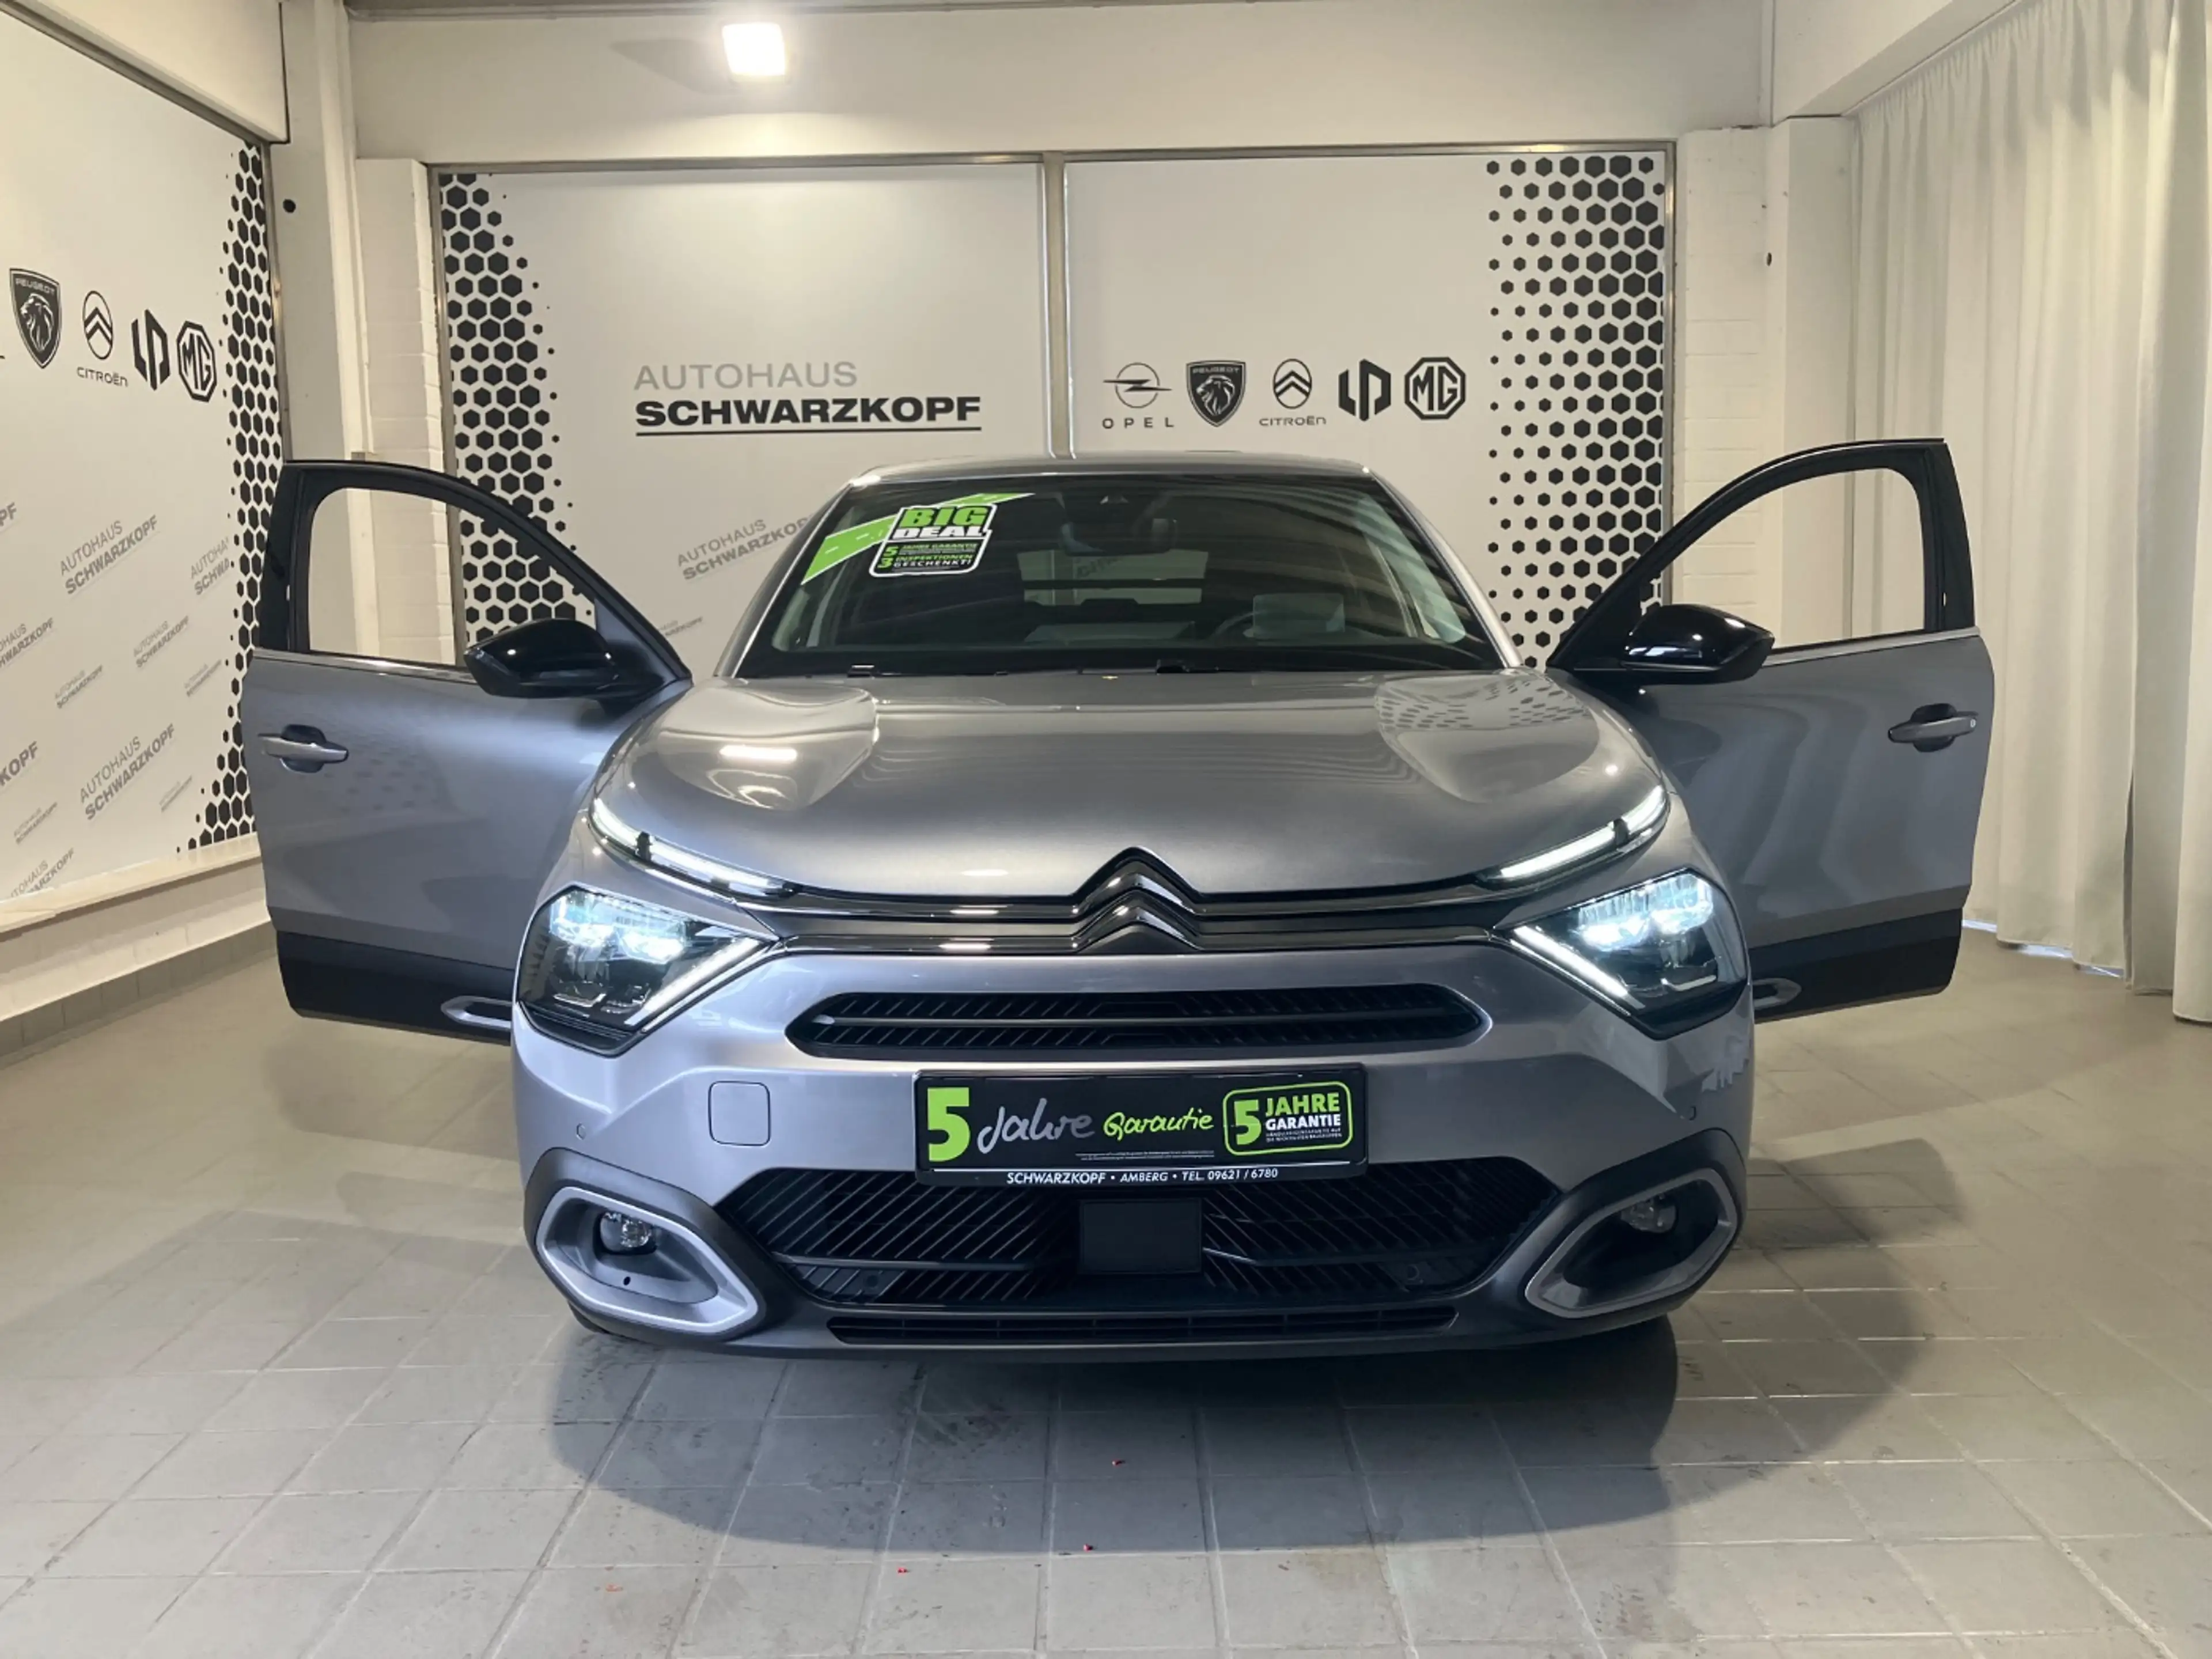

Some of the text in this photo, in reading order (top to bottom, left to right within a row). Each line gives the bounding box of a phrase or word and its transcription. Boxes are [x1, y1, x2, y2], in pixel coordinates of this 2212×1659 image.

[180, 329, 214, 394] MG
[634, 362, 857, 390] AUTOHAUS
[1192, 366, 1240, 374] PEUGEOT
[1410, 363, 1461, 414] MG
[635, 396, 981, 426] SCHWARZKOPF
[1103, 418, 1174, 429] OPEL
[899, 506, 988, 527] BIG
[677, 520, 766, 567] AUTOHAUS
[893, 525, 983, 539] DEAL
[60, 520, 123, 576] AUTOHAUS
[65, 514, 157, 595] SCHWARZKOPF
[877, 557, 894, 569] 3
[883, 546, 899, 557] 5
[80, 736, 141, 804] AUTOHAUS
[85, 723, 175, 820] SCHWARZKOPF
[927, 1087, 1214, 1162] 5 Jahre Garantie
[1233, 1092, 1340, 1145] 5 JAHRE
[1266, 1113, 1342, 1131] GARANTIE
[1006, 1172, 1106, 1185] SCHWARZKOPF
[1120, 1172, 1169, 1183] AMBERG
[1207, 1170, 1240, 1180] 09621
[1251, 1168, 1278, 1180] 6780
